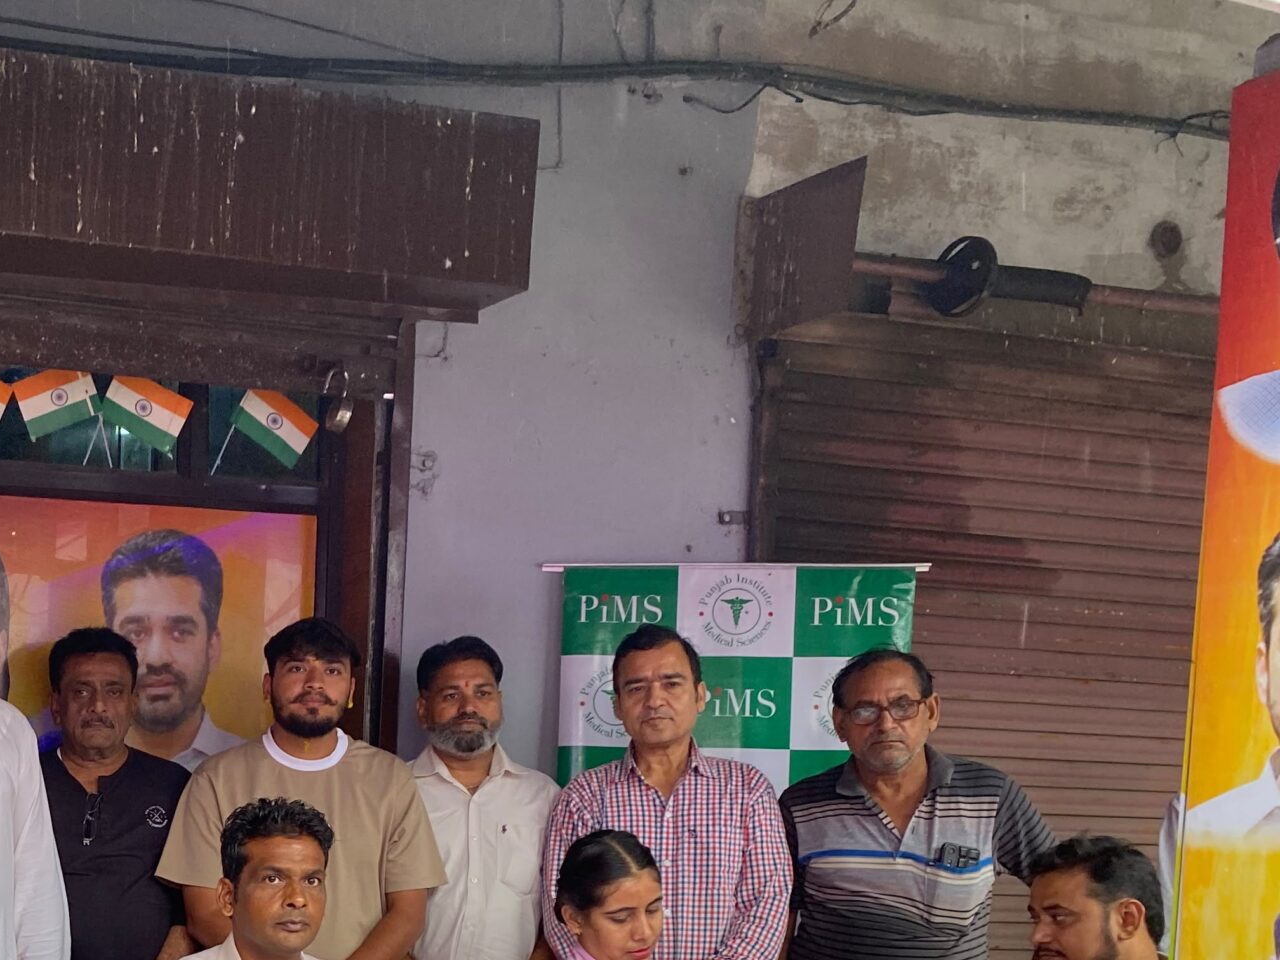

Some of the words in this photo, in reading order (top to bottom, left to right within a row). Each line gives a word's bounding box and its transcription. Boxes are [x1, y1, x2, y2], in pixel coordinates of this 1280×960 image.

[699, 575, 732, 606] Punjab
[736, 573, 772, 606] Institute
[577, 594, 662, 624] PiMS
[810, 595, 899, 626] PiMS
[704, 621, 734, 648] Medical
